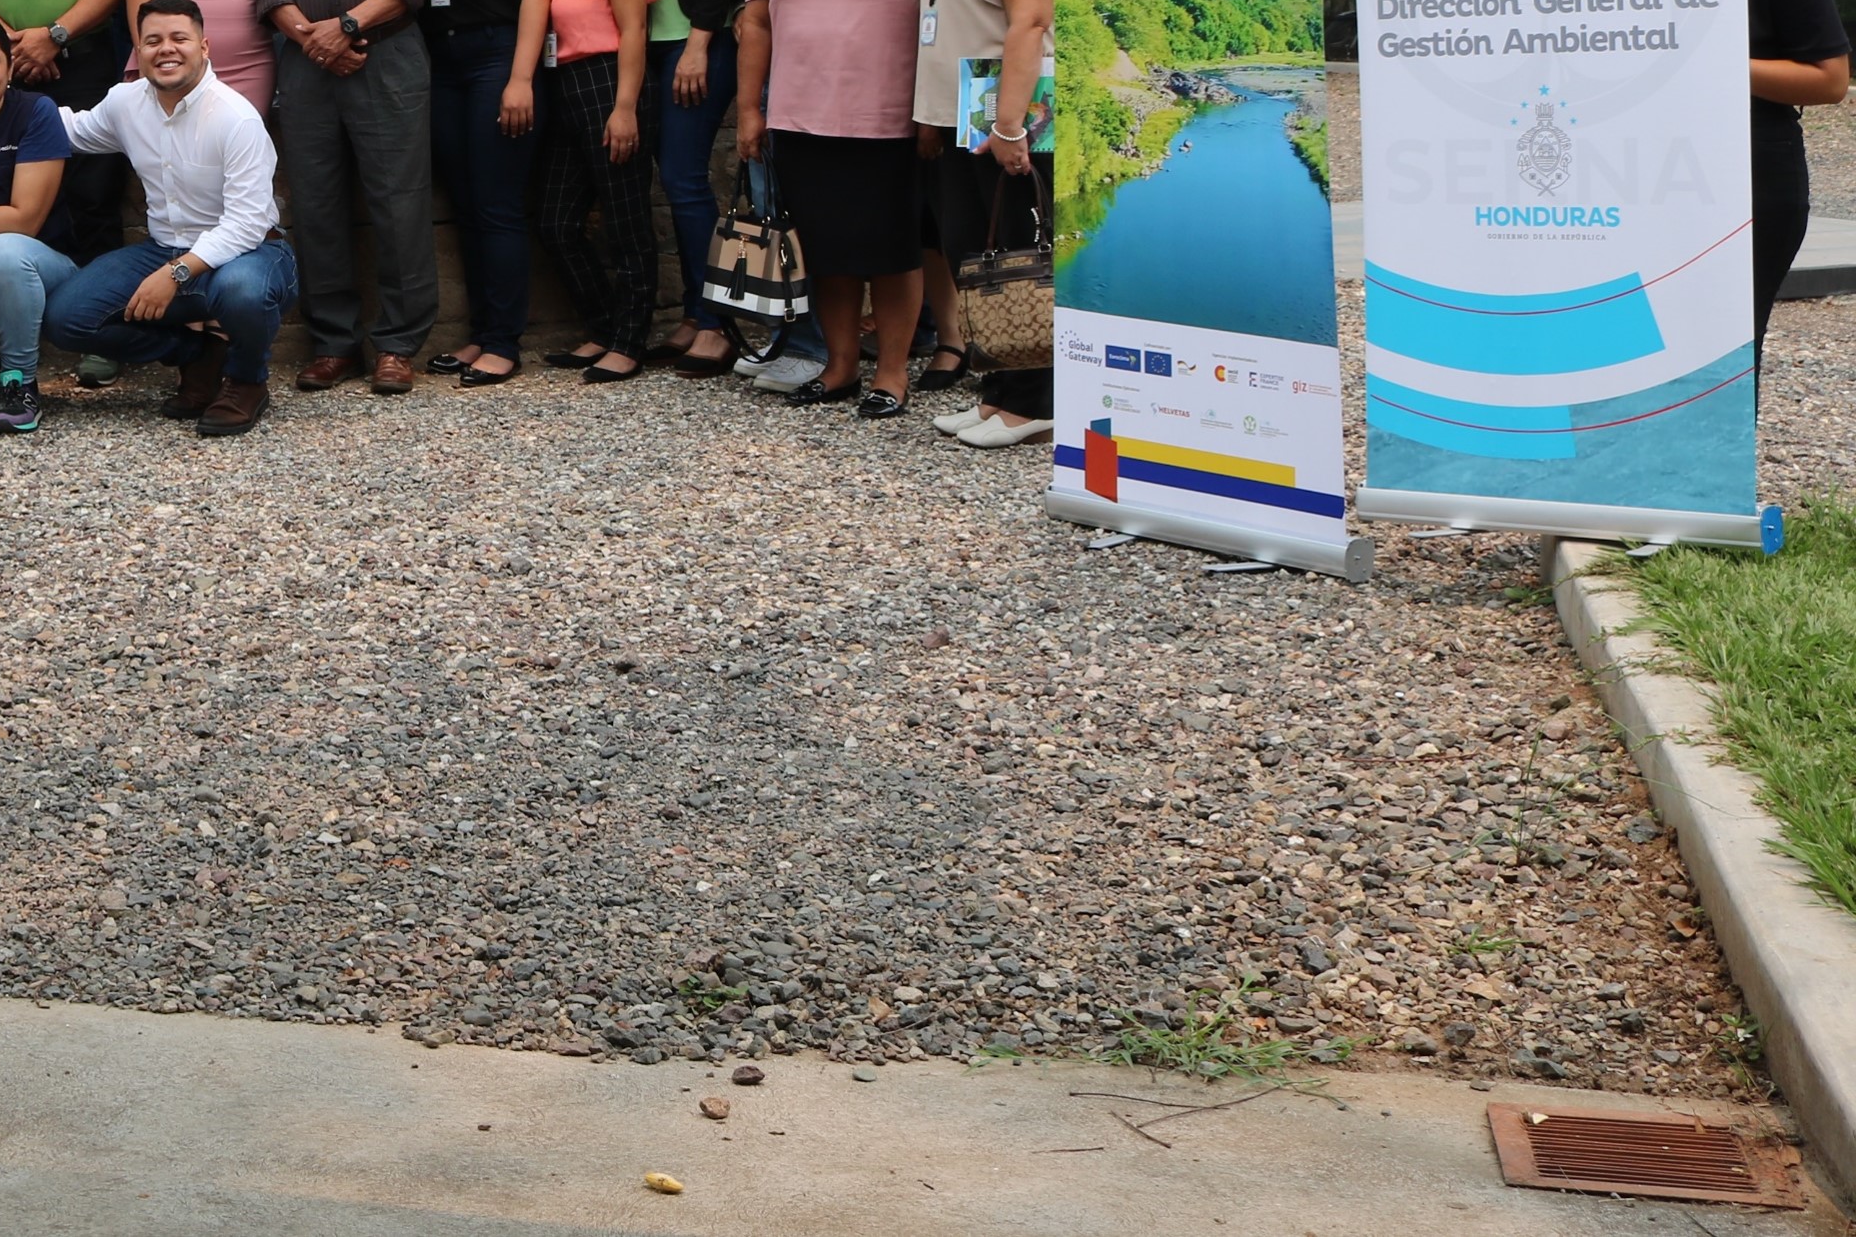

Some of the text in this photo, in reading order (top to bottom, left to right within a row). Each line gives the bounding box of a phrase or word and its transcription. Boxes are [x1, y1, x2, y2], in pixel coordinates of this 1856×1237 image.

[1378, 22, 1679, 58] Gestión Ambiental
[1475, 206, 1621, 228] HONDURAS
[1560, 232, 1607, 241] REPÚBLICA
[1068, 340, 1093, 353] Global
[1068, 351, 1103, 367] Gateway
[1292, 380, 1307, 394] giz
[1158, 406, 1190, 418] HELVETAS
